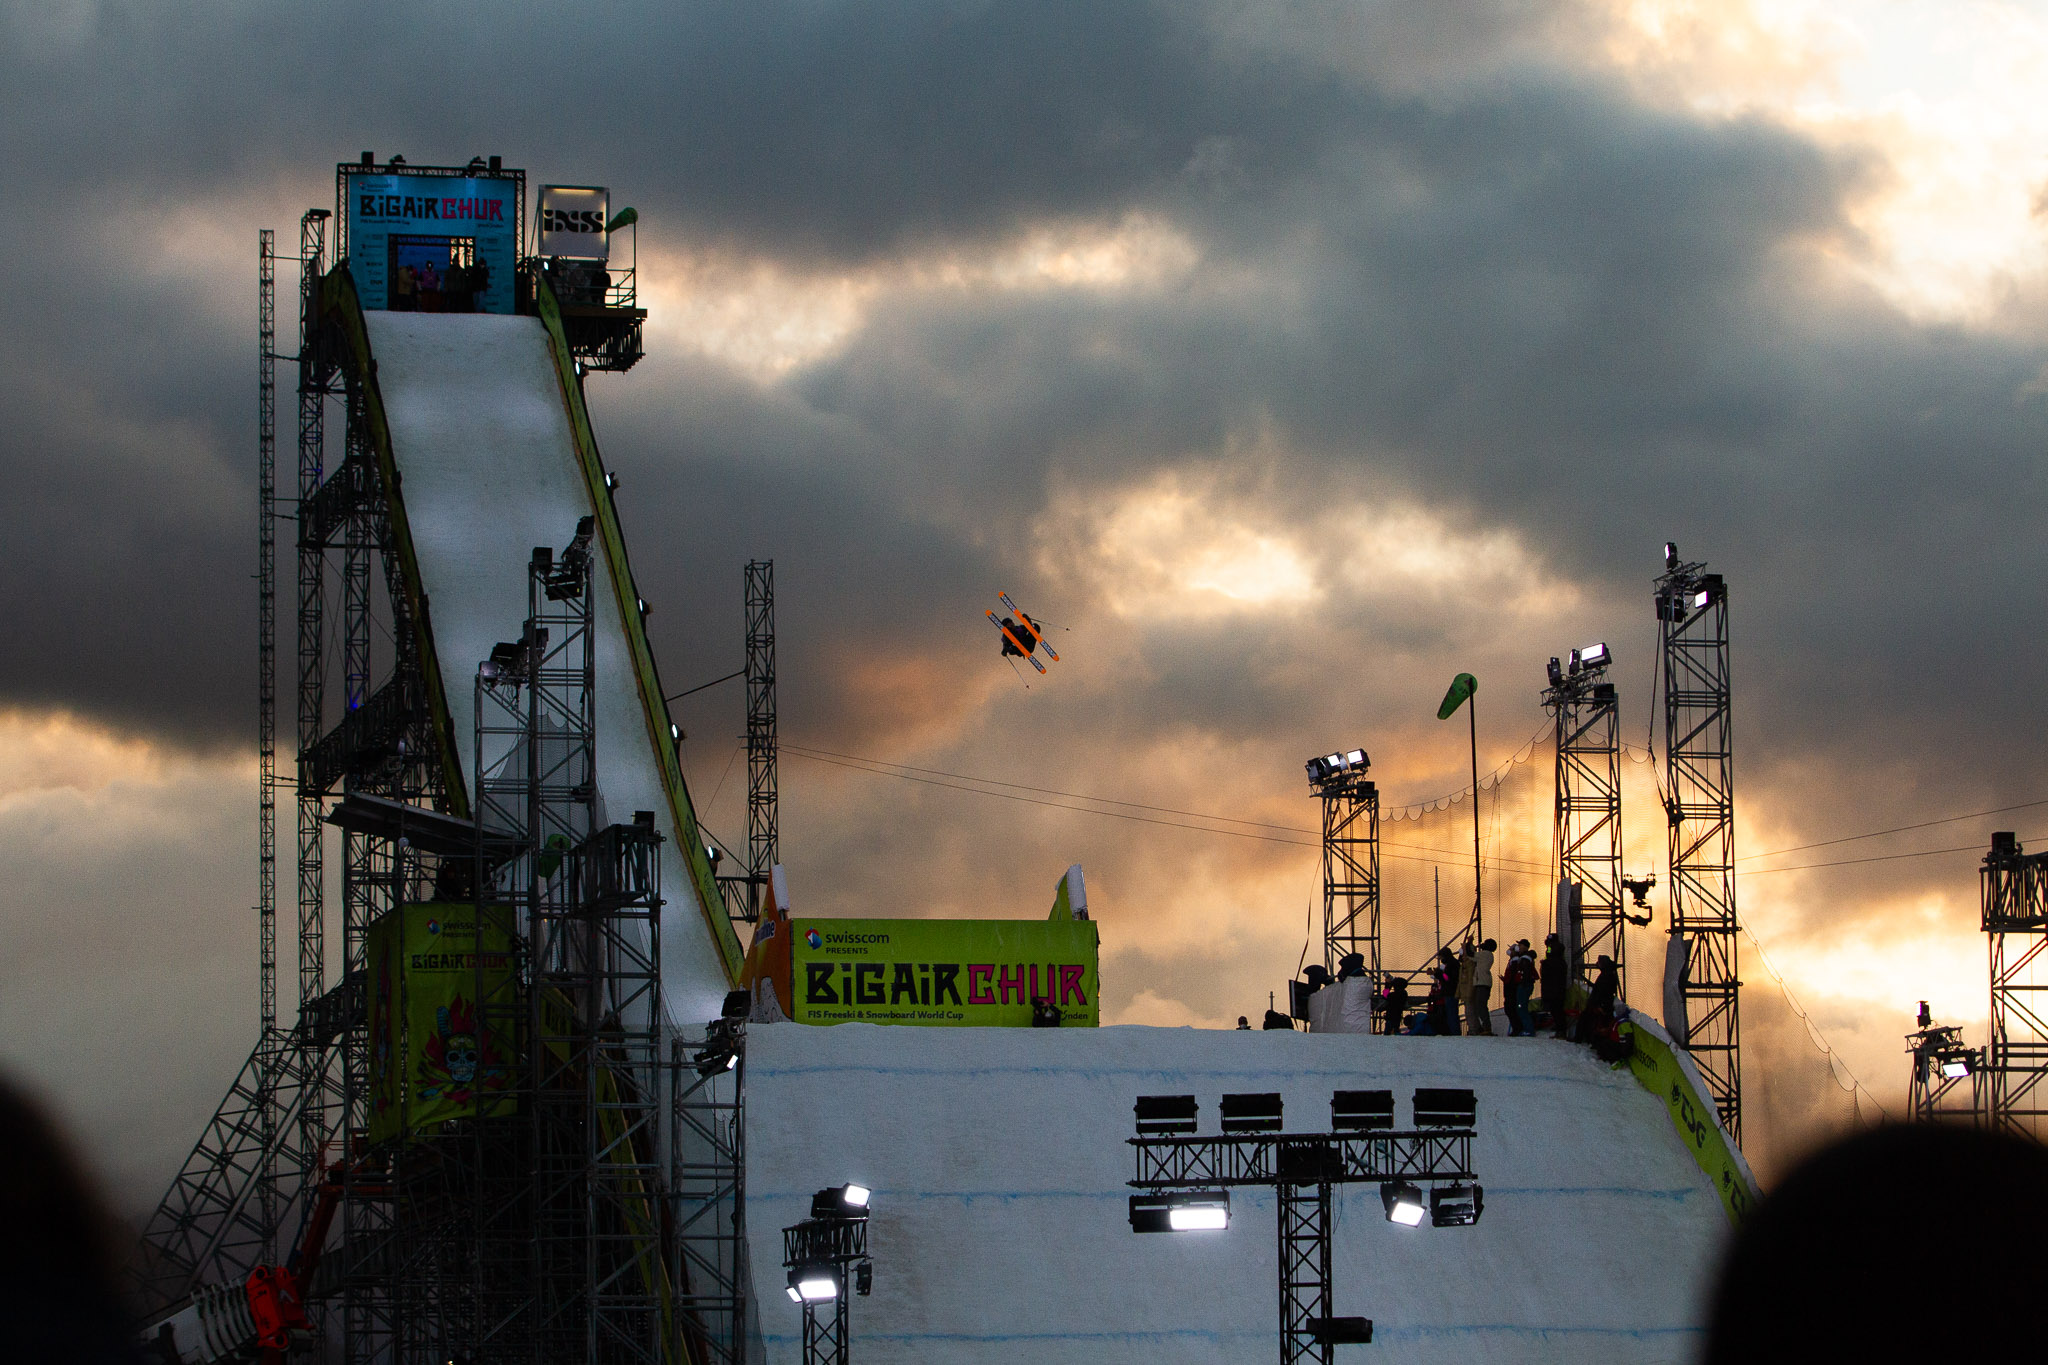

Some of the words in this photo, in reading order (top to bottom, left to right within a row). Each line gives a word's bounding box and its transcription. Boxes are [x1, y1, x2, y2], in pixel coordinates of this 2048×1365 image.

[442, 198, 504, 221] CHUR
[443, 920, 491, 930] swisscm
[825, 931, 890, 945] swisscom
[825, 947, 869, 955] PRESENTS
[967, 962, 1088, 1006] CHUR
[807, 1010, 822, 1019] FIS
[824, 1010, 856, 1019] Freeski
[857, 1011, 864, 1019] &
[866, 1010, 915, 1020] Snowboard
[918, 1011, 944, 1020] World
[946, 1011, 964, 1021] Cup
